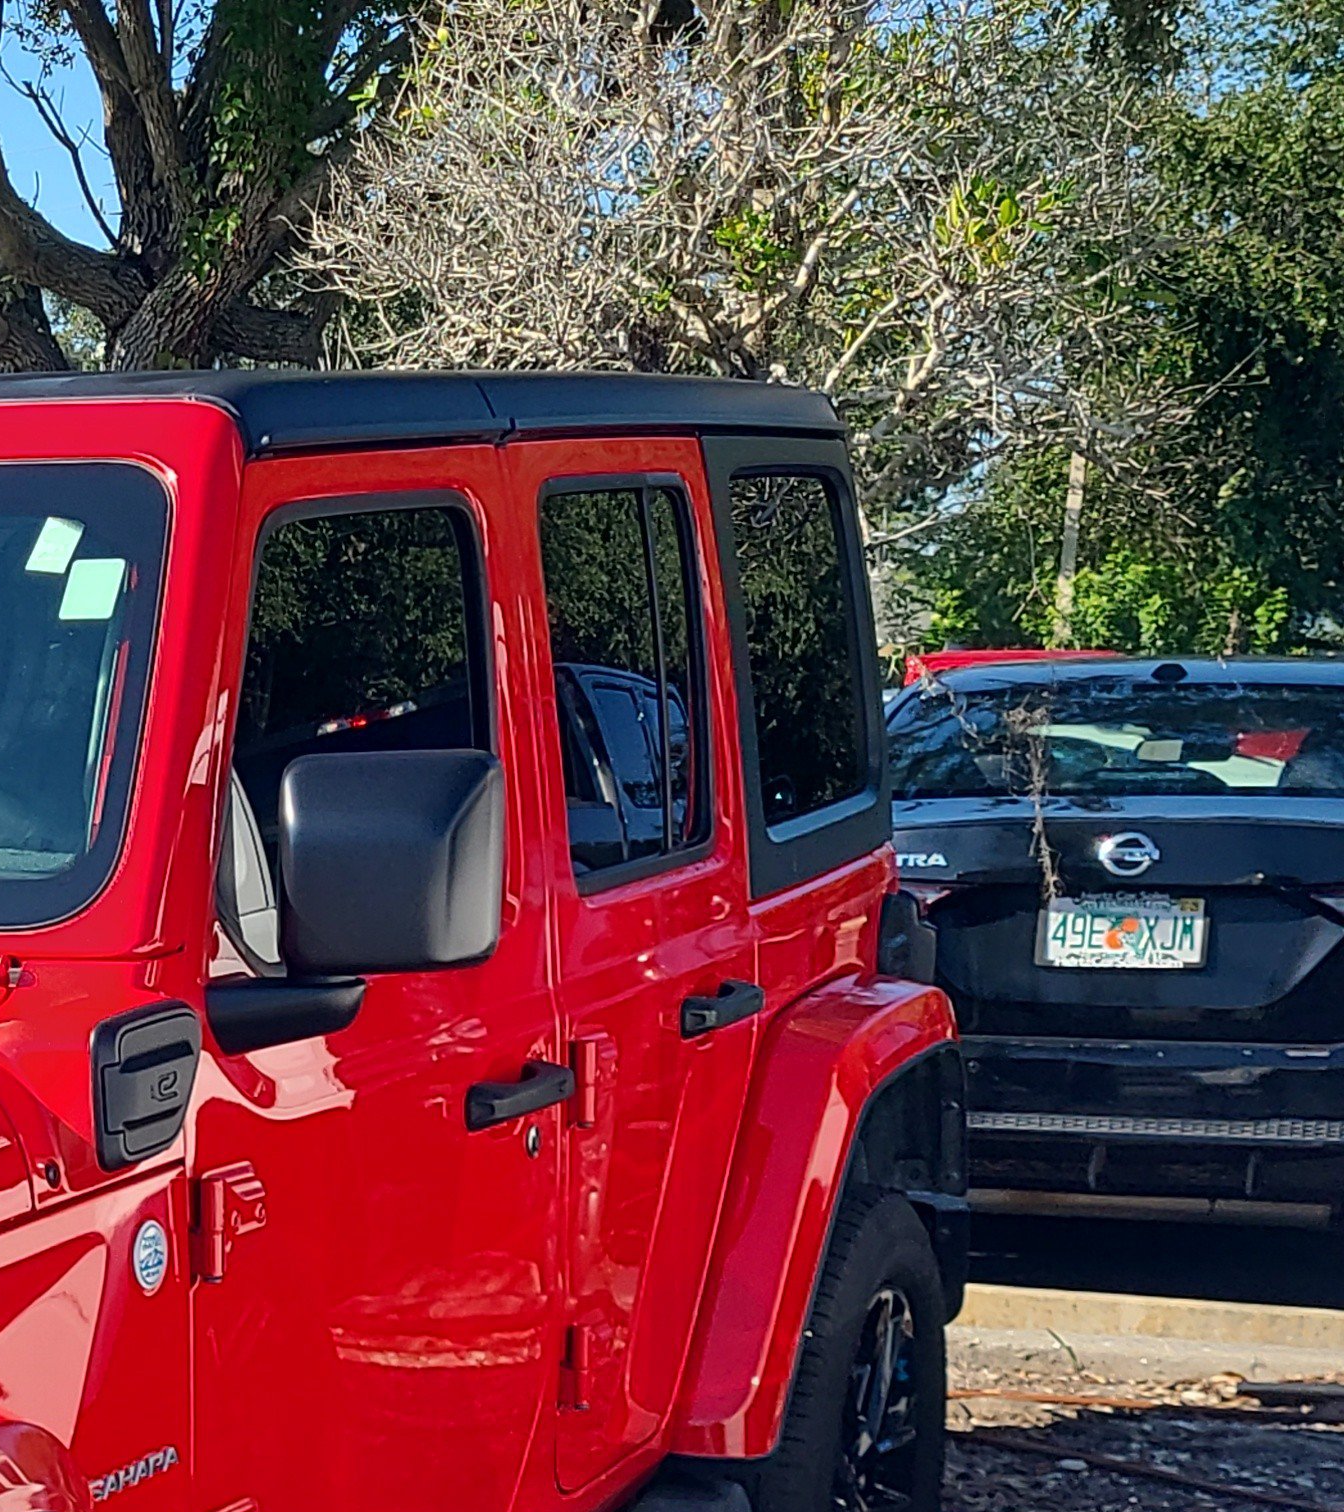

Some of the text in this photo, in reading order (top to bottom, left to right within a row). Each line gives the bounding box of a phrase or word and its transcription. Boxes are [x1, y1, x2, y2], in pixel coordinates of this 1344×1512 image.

[1051, 914, 1195, 951] 49E XJM
[87, 1446, 179, 1501] SAHARA
